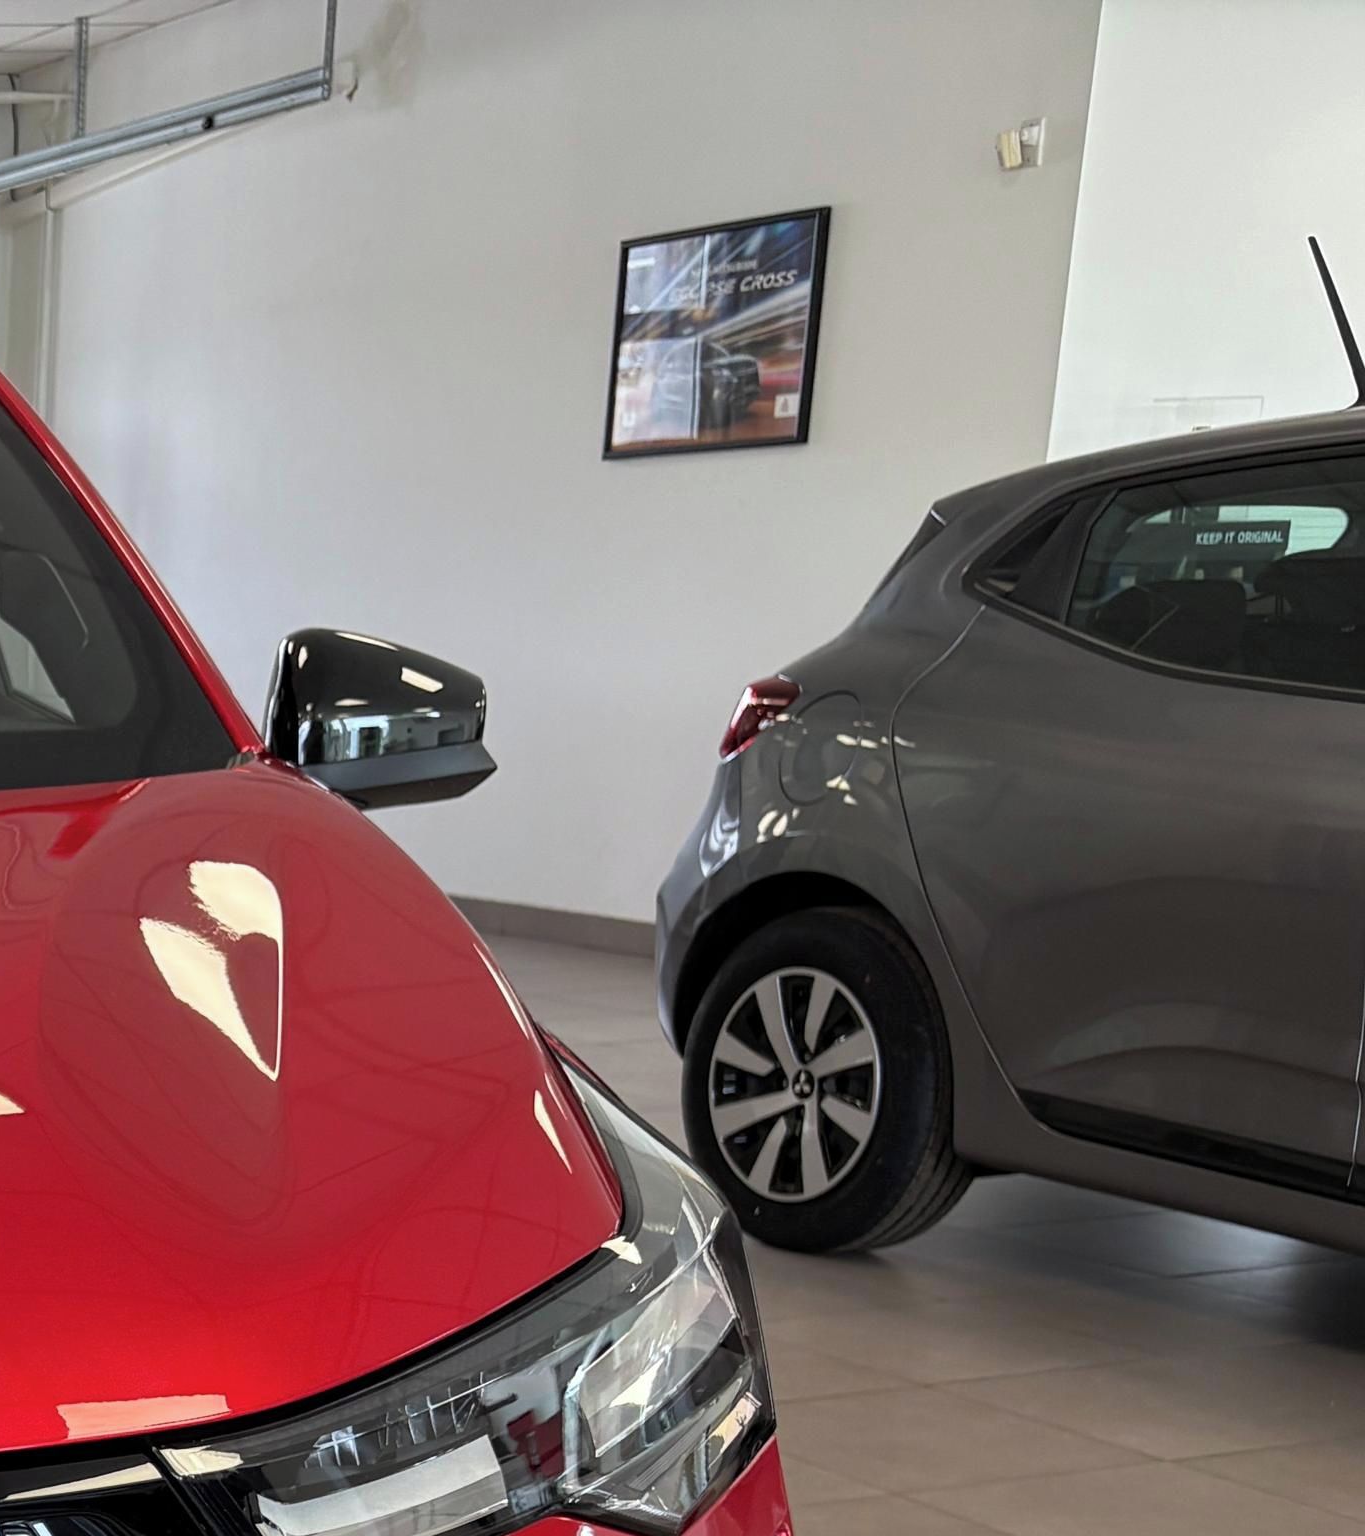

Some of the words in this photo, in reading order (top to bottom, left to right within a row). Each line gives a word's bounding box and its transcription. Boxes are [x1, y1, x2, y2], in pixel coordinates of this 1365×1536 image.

[739, 269, 798, 293] CROSS
[1195, 531, 1223, 545] KEEP
[1224, 531, 1236, 544] IT
[1237, 530, 1284, 544] ORIGINAL
